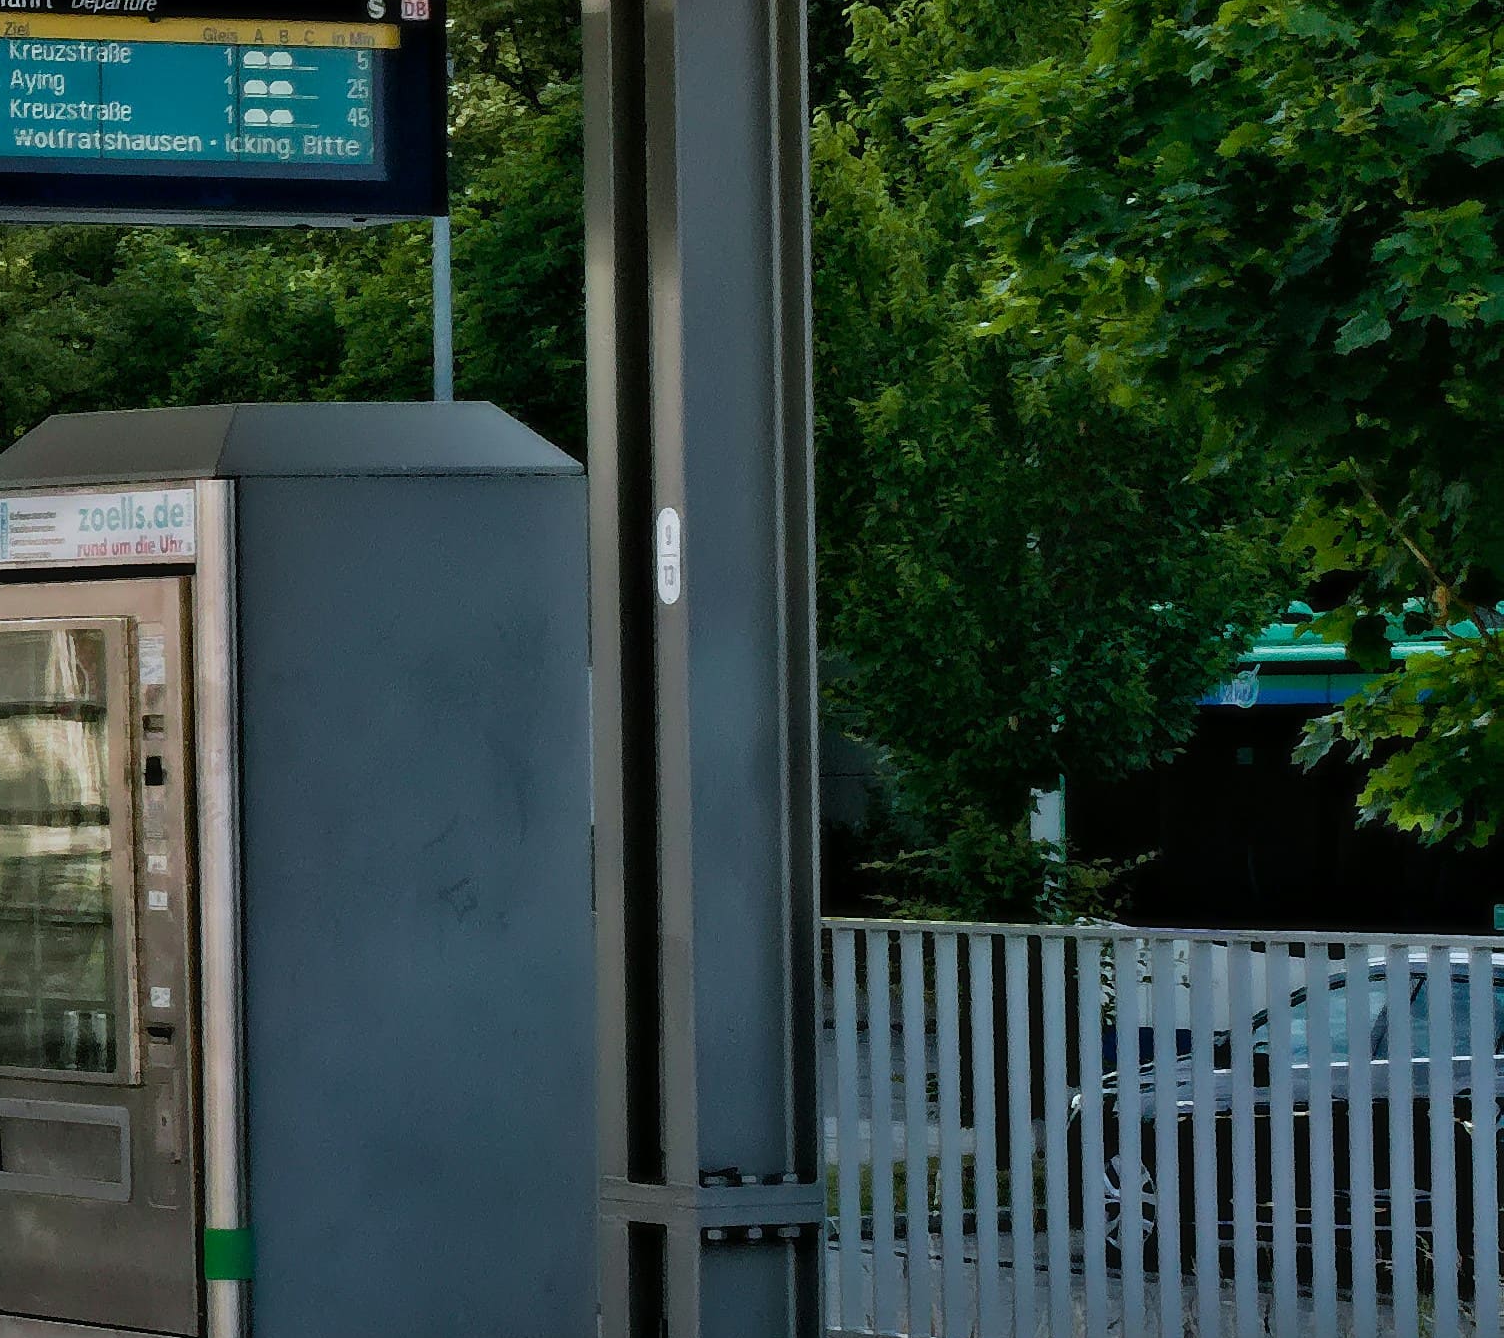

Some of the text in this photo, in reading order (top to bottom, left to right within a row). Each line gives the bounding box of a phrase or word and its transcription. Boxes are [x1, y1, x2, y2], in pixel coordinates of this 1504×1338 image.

[402, 0, 429, 19] DB
[4, 21, 30, 36] Ziel
[203, 27, 238, 43] Gleis
[254, 28, 265, 44] A
[279, 29, 290, 44] B
[303, 29, 315, 44] C
[9, 42, 132, 64] Kreuzstraße
[224, 48, 234, 66] 1
[357, 50, 369, 70] 5
[9, 70, 66, 96] Aying
[224, 75, 234, 95] 1
[346, 78, 369, 99] 25
[9, 100, 133, 121] Kreuzstraße
[224, 105, 234, 124] 1
[347, 107, 370, 128] 45
[13, 127, 202, 153] Wolfratshausen
[303, 135, 361, 155] Bitte
[77, 494, 185, 533] zoells.de
[76, 537, 108, 558] rund
[111, 540, 132, 556] um
[135, 534, 157, 555] die
[159, 533, 184, 554] Uhr
